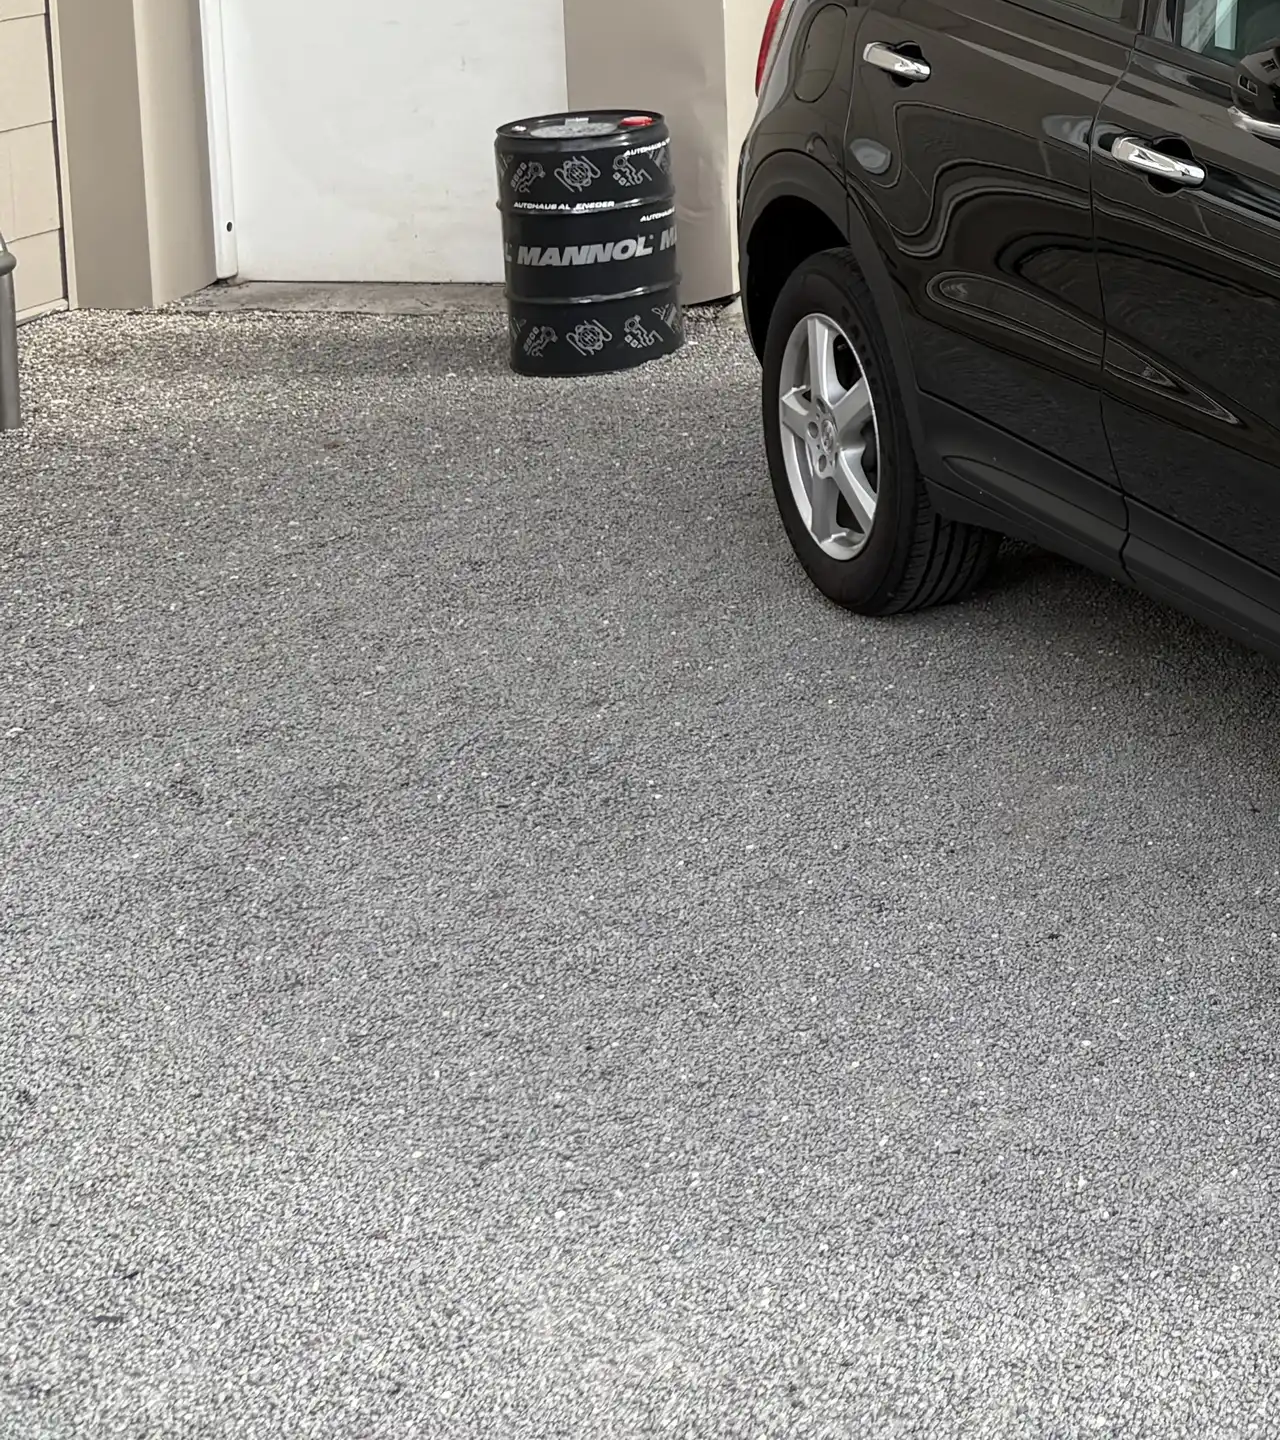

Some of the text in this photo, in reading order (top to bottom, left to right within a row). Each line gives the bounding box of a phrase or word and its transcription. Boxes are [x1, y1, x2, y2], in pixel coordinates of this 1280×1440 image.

[513, 200, 616, 212] AUTOHAUS ALENEDER
[517, 235, 654, 267] MANNOL
